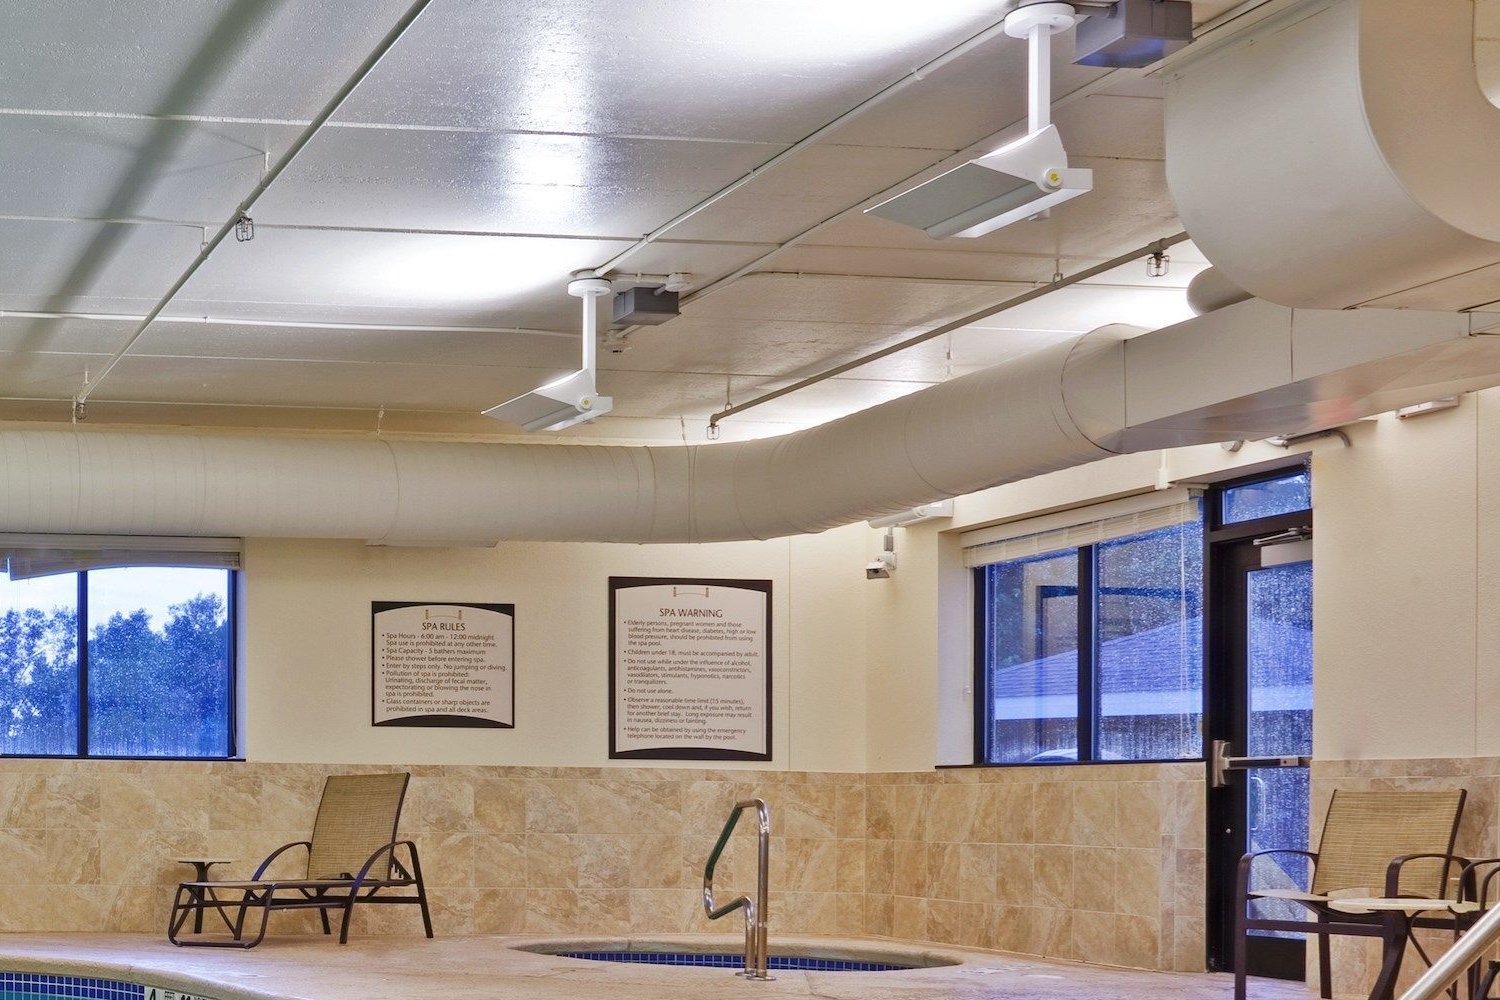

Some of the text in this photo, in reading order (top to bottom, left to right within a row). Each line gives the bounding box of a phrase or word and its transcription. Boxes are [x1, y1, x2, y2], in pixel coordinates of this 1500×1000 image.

[660, 608, 723, 618] SPA WARNING
[422, 622, 466, 631] SPA RULES
